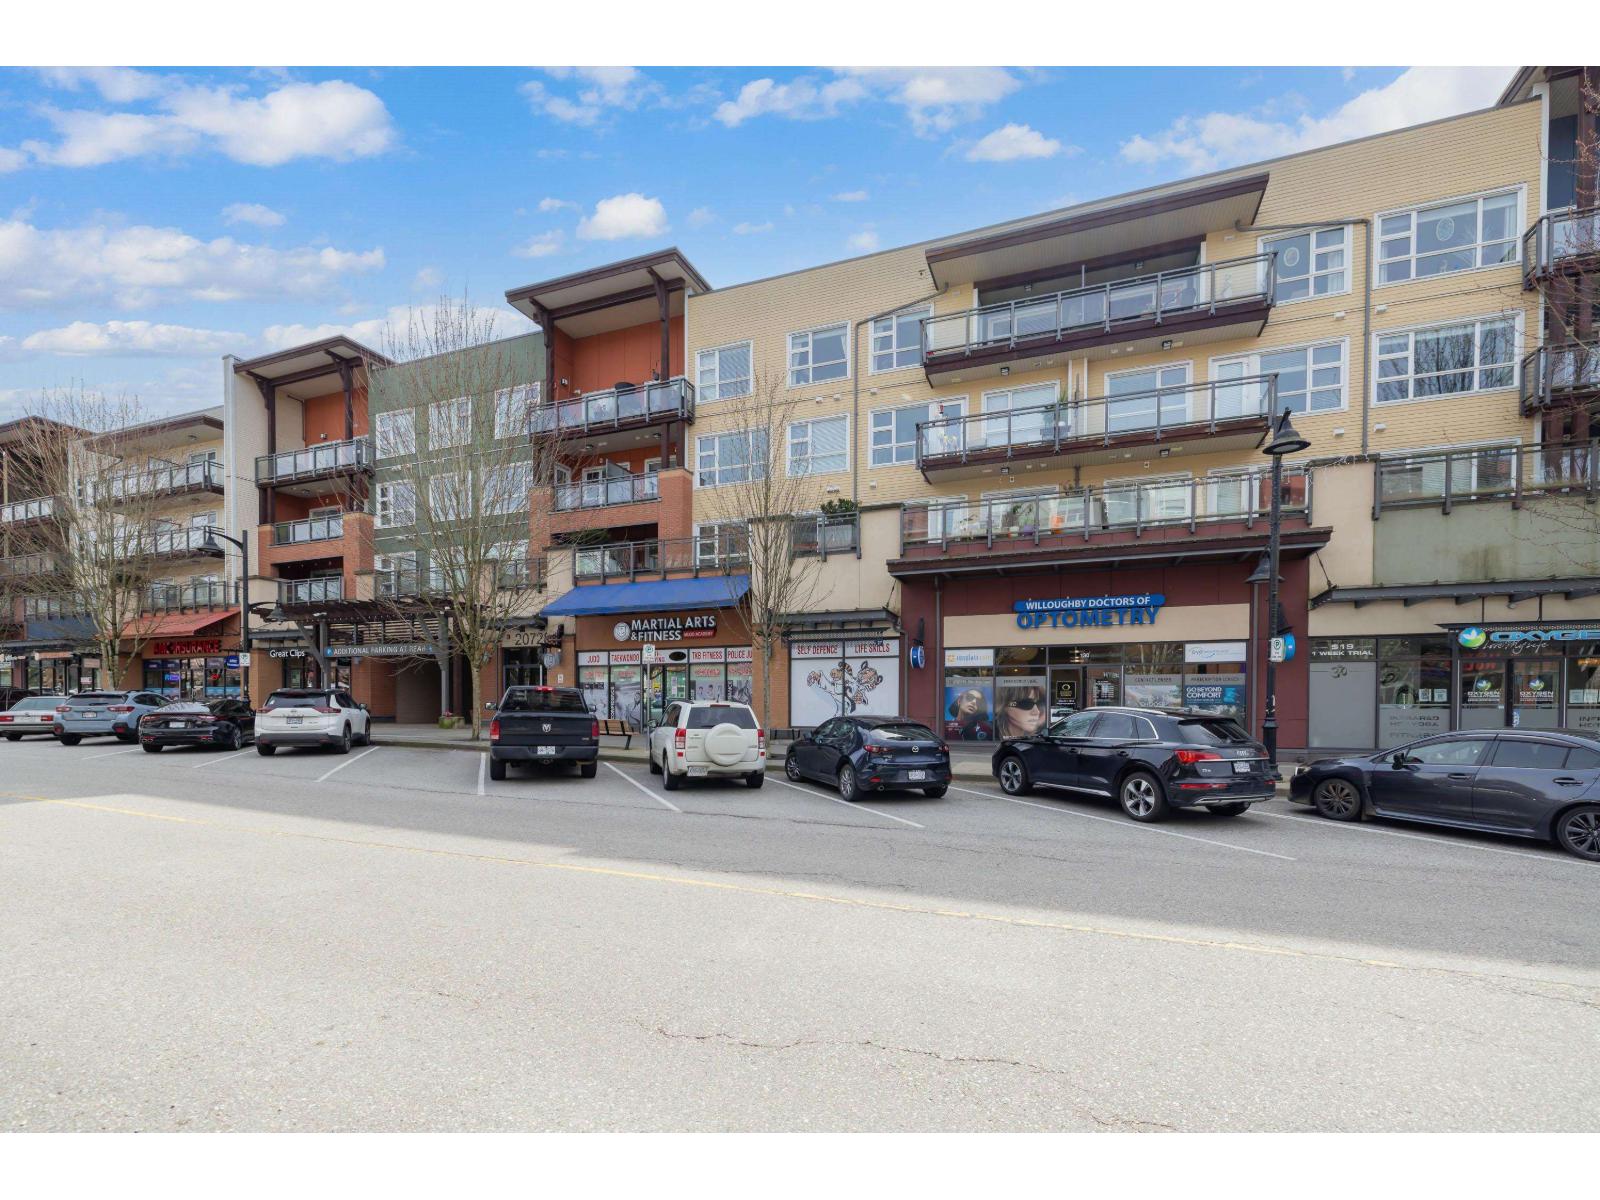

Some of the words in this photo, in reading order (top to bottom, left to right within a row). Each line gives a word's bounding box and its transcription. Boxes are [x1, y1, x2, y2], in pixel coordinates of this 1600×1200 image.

[1026, 599, 1086, 610] WILLOUGHBY
[1089, 598, 1134, 608] DOCTORS
[1136, 596, 1150, 605] OF
[631, 617, 682, 630] MARTIAL
[685, 615, 716, 628] ARTS
[1017, 607, 1160, 629] OPTOMETRY
[630, 630, 682, 641] &FITNESS
[333, 647, 369, 655] ADDITIONAL
[370, 645, 397, 654] PARKING
[399, 645, 408, 653] AT
[797, 645, 811, 655] SELF
[812, 645, 838, 655] DEFENCE
[855, 643, 868, 653] LIFE
[869, 643, 890, 653] SKILLS
[269, 649, 288, 658] Great
[289, 648, 305, 659] Clips
[703, 650, 722, 660] FITNESS
[727, 649, 745, 659] POLICE
